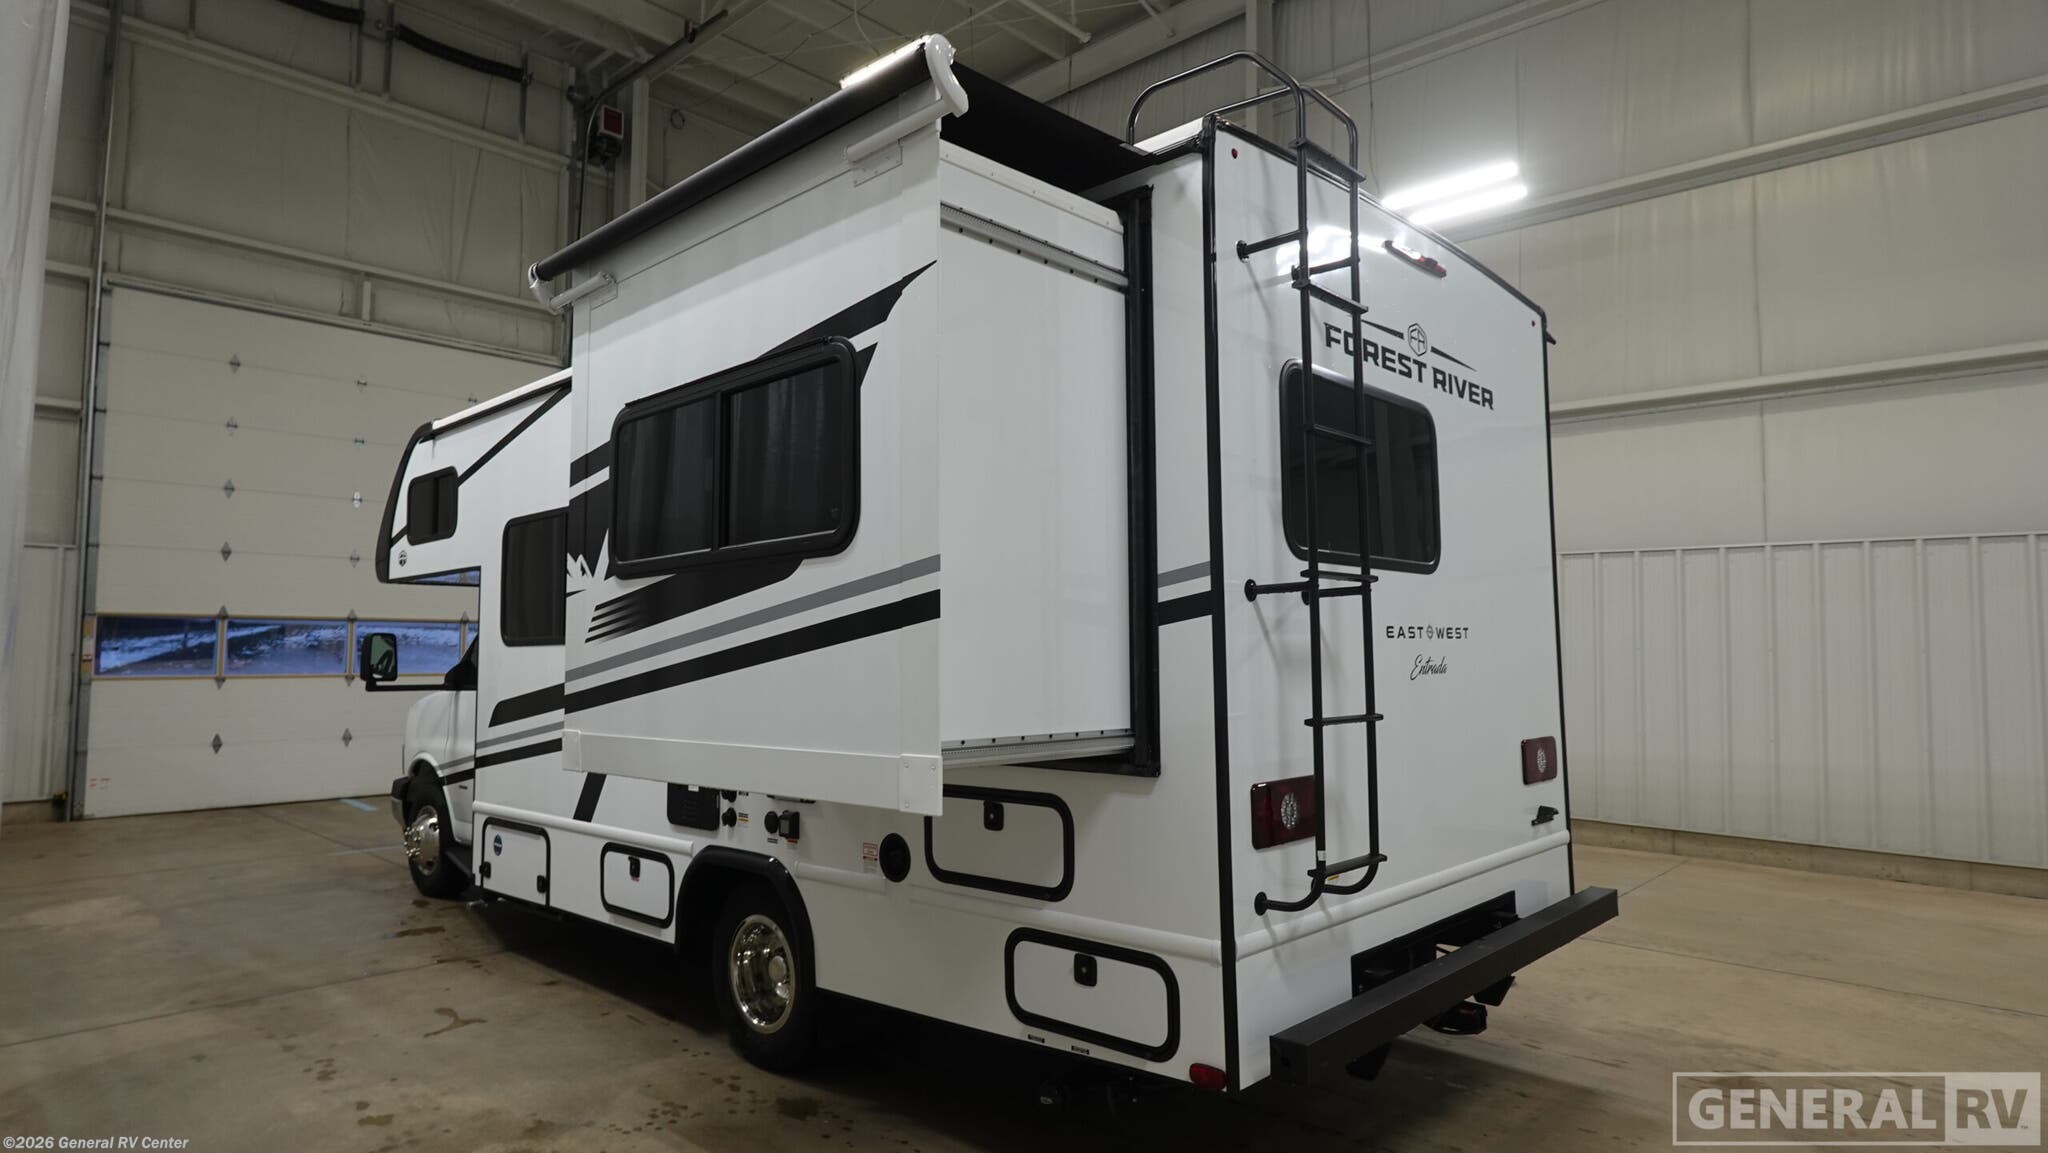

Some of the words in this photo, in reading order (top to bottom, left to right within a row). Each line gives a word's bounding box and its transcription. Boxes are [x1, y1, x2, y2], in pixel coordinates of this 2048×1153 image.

[1324, 322, 1427, 383] FOREST
[1431, 366, 1494, 410] RIVER
[1386, 626, 1424, 639] EAST
[1435, 627, 1469, 639] WEST
[1410, 654, 1448, 680] Entrada
